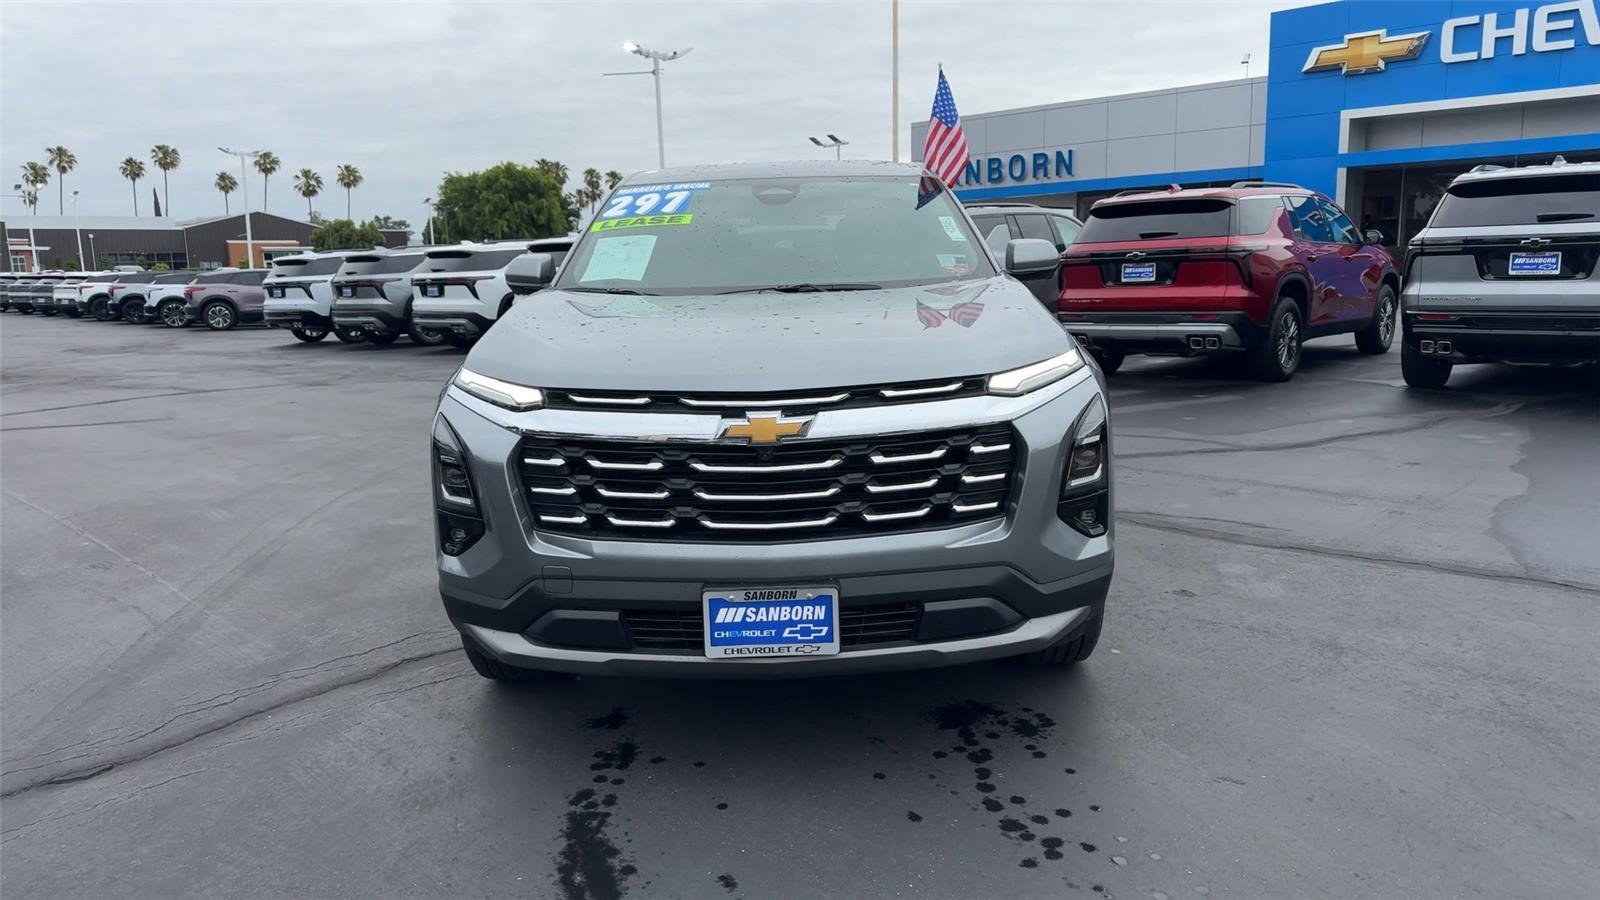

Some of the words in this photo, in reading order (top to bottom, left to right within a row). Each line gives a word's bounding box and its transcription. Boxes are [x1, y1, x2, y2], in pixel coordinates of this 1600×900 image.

[957, 149, 1074, 186] NBORN
[602, 190, 691, 217] 297
[599, 215, 685, 230] LEASE
[744, 590, 797, 601] SANBORN
[746, 605, 826, 622] SANBORN
[714, 629, 777, 638] CHEVROLET
[724, 645, 793, 655] CHEVROLET
